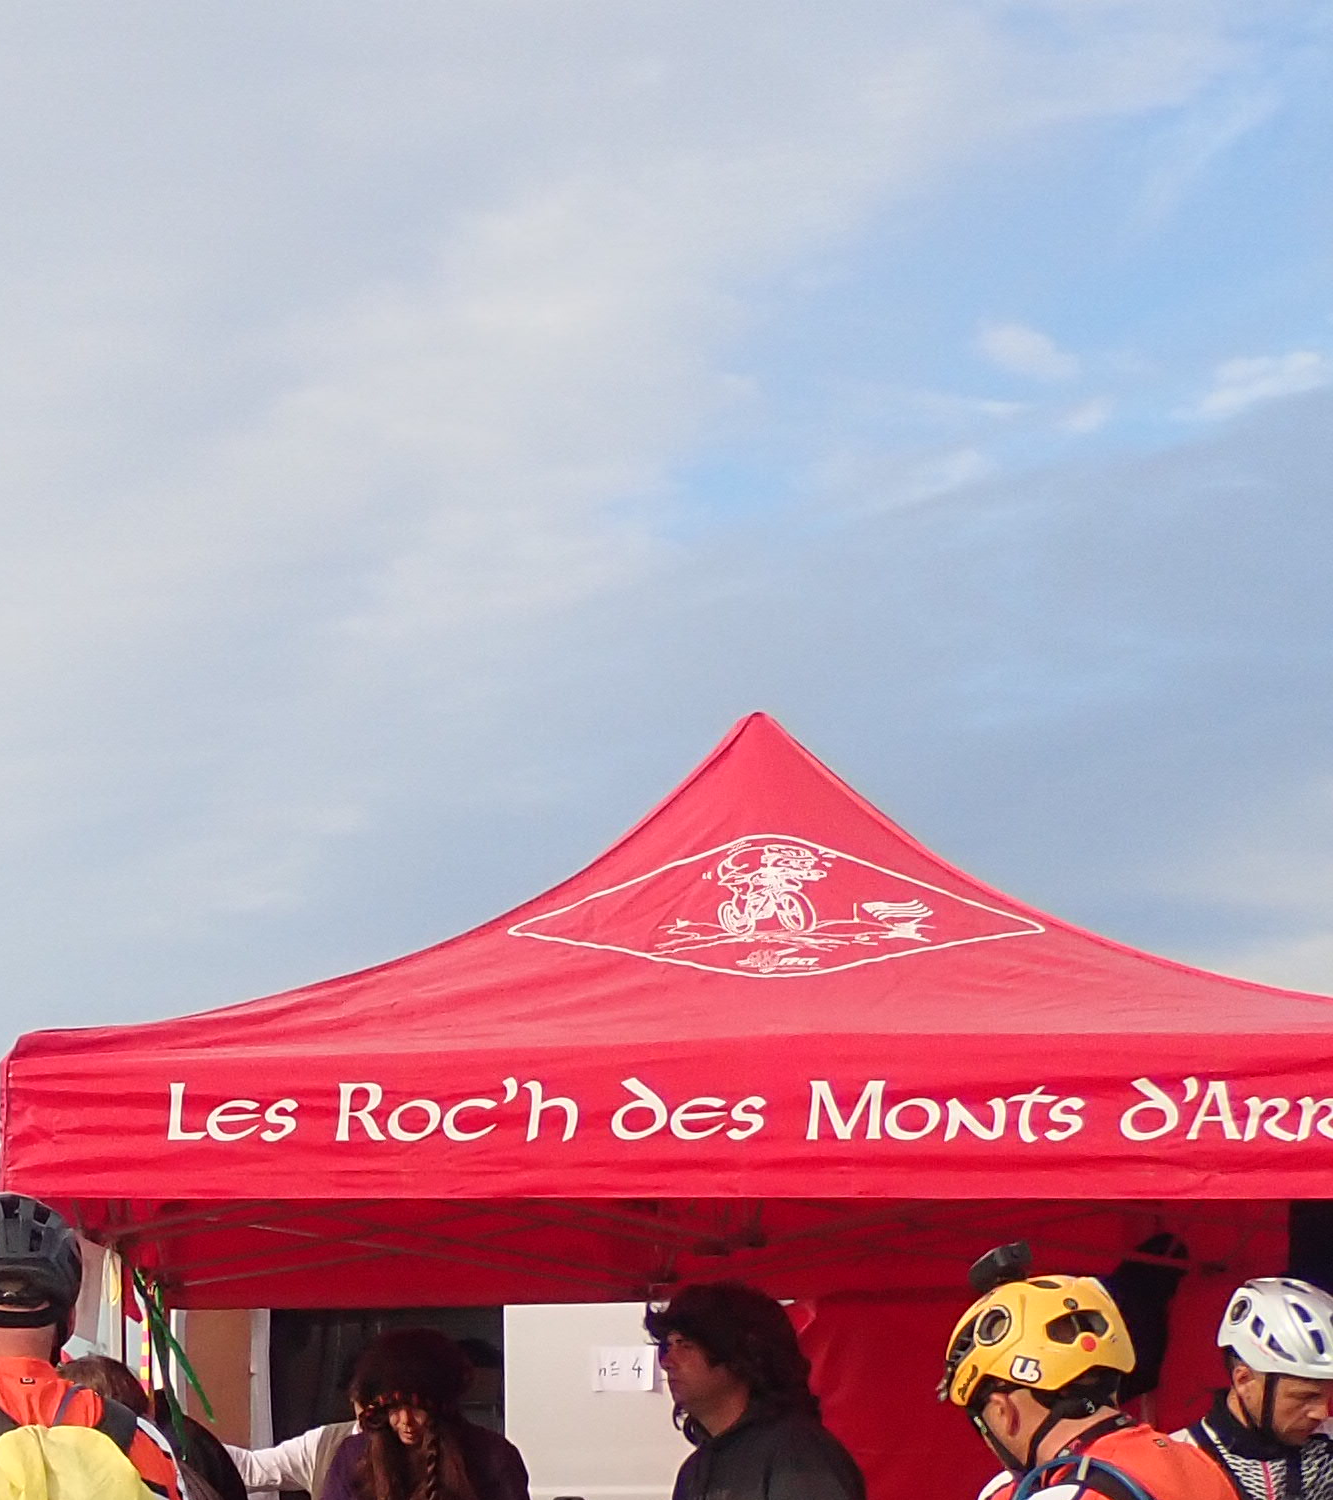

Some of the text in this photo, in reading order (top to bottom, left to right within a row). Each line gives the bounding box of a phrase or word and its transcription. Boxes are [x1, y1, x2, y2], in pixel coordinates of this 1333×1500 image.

[167, 1081, 300, 1143] Les
[334, 1076, 579, 1143] Roc'h
[610, 1076, 767, 1142] des
[805, 1080, 1086, 1143] Monts
[631, 1356, 643, 1379] 4
